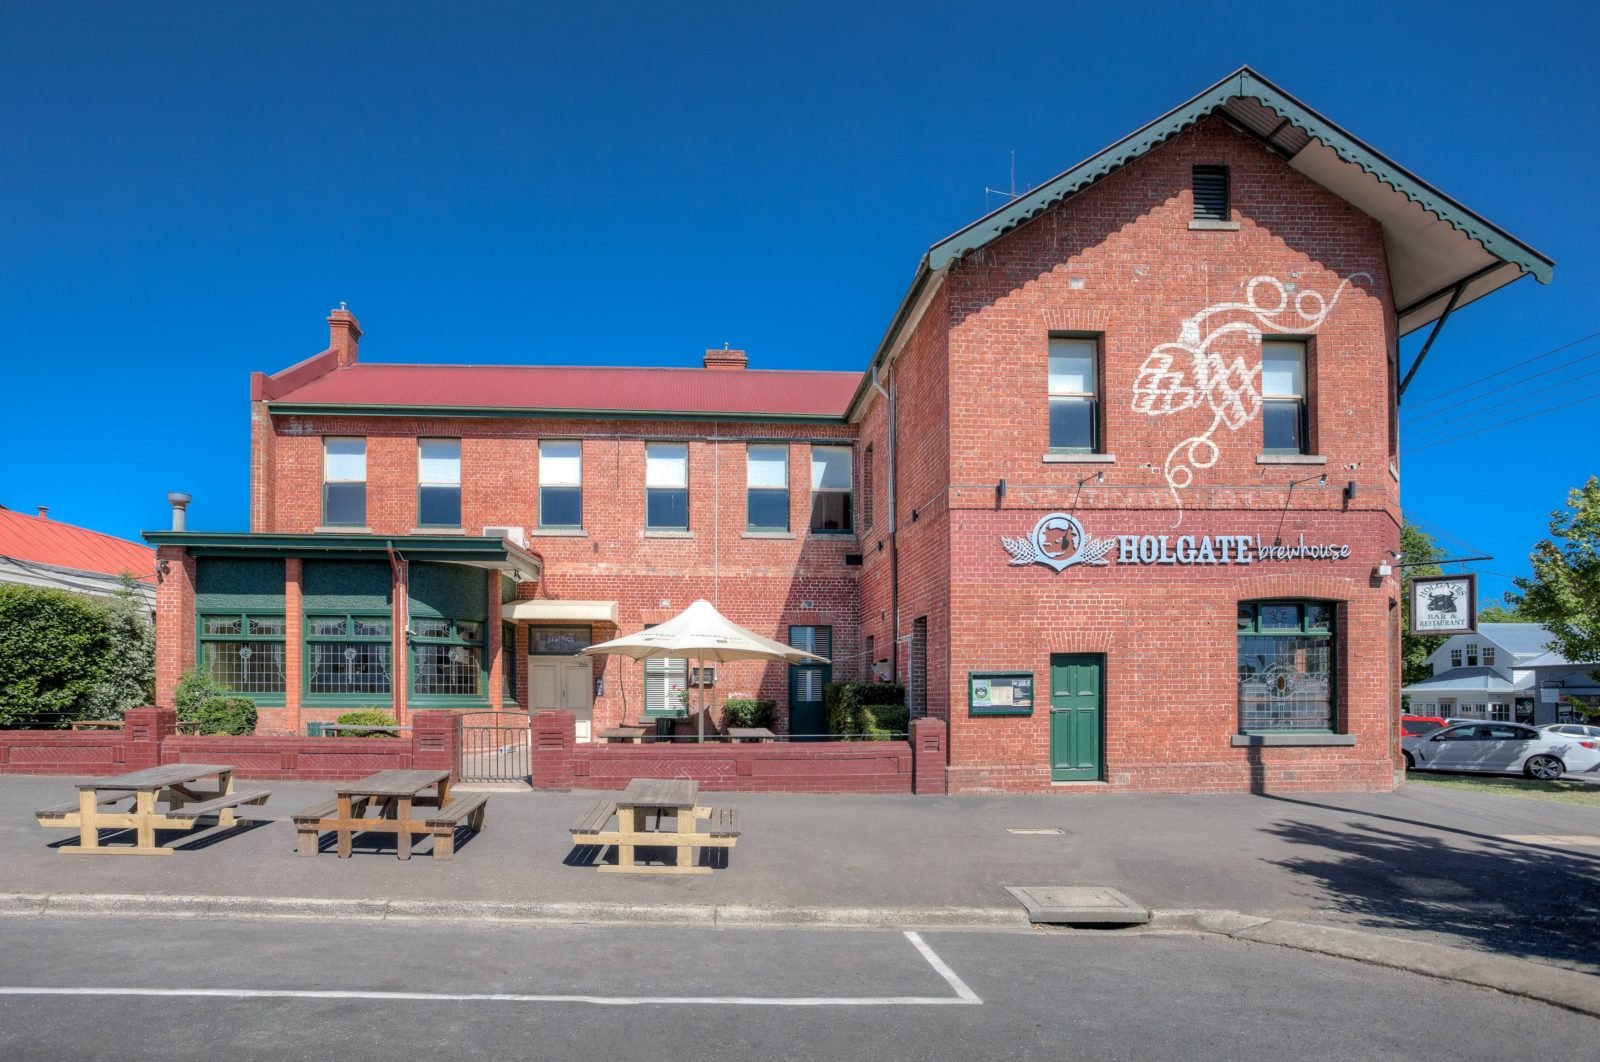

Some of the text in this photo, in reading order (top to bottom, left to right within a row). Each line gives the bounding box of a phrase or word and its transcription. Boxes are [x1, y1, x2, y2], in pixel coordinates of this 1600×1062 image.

[1117, 533, 1352, 564] HOLGATE brewhouse
[1418, 582, 1466, 598] HOLGATES
[1420, 619, 1465, 627] RESTAURANT
